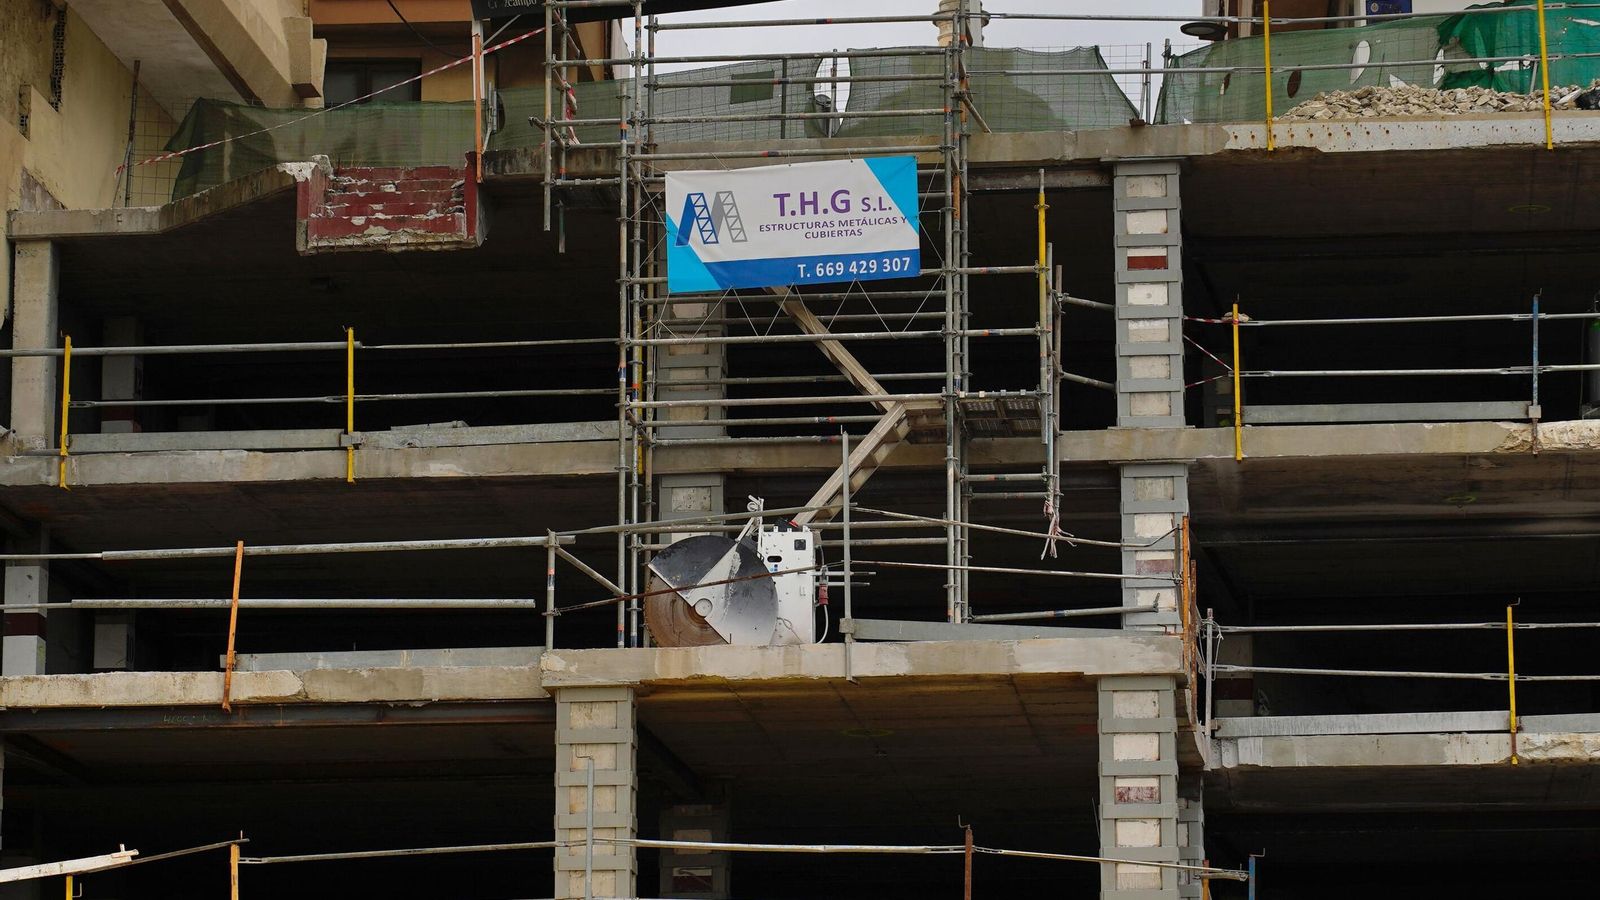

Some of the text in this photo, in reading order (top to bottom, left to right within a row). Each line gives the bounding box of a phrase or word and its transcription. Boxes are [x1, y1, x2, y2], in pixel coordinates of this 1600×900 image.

[773, 189, 892, 217] T.H.G S.L.
[759, 216, 907, 232] ESTRUCTURAS METÁLICAS Y
[804, 229, 863, 239] CUBIERTAS
[797, 257, 911, 278] T. 669 429 307
